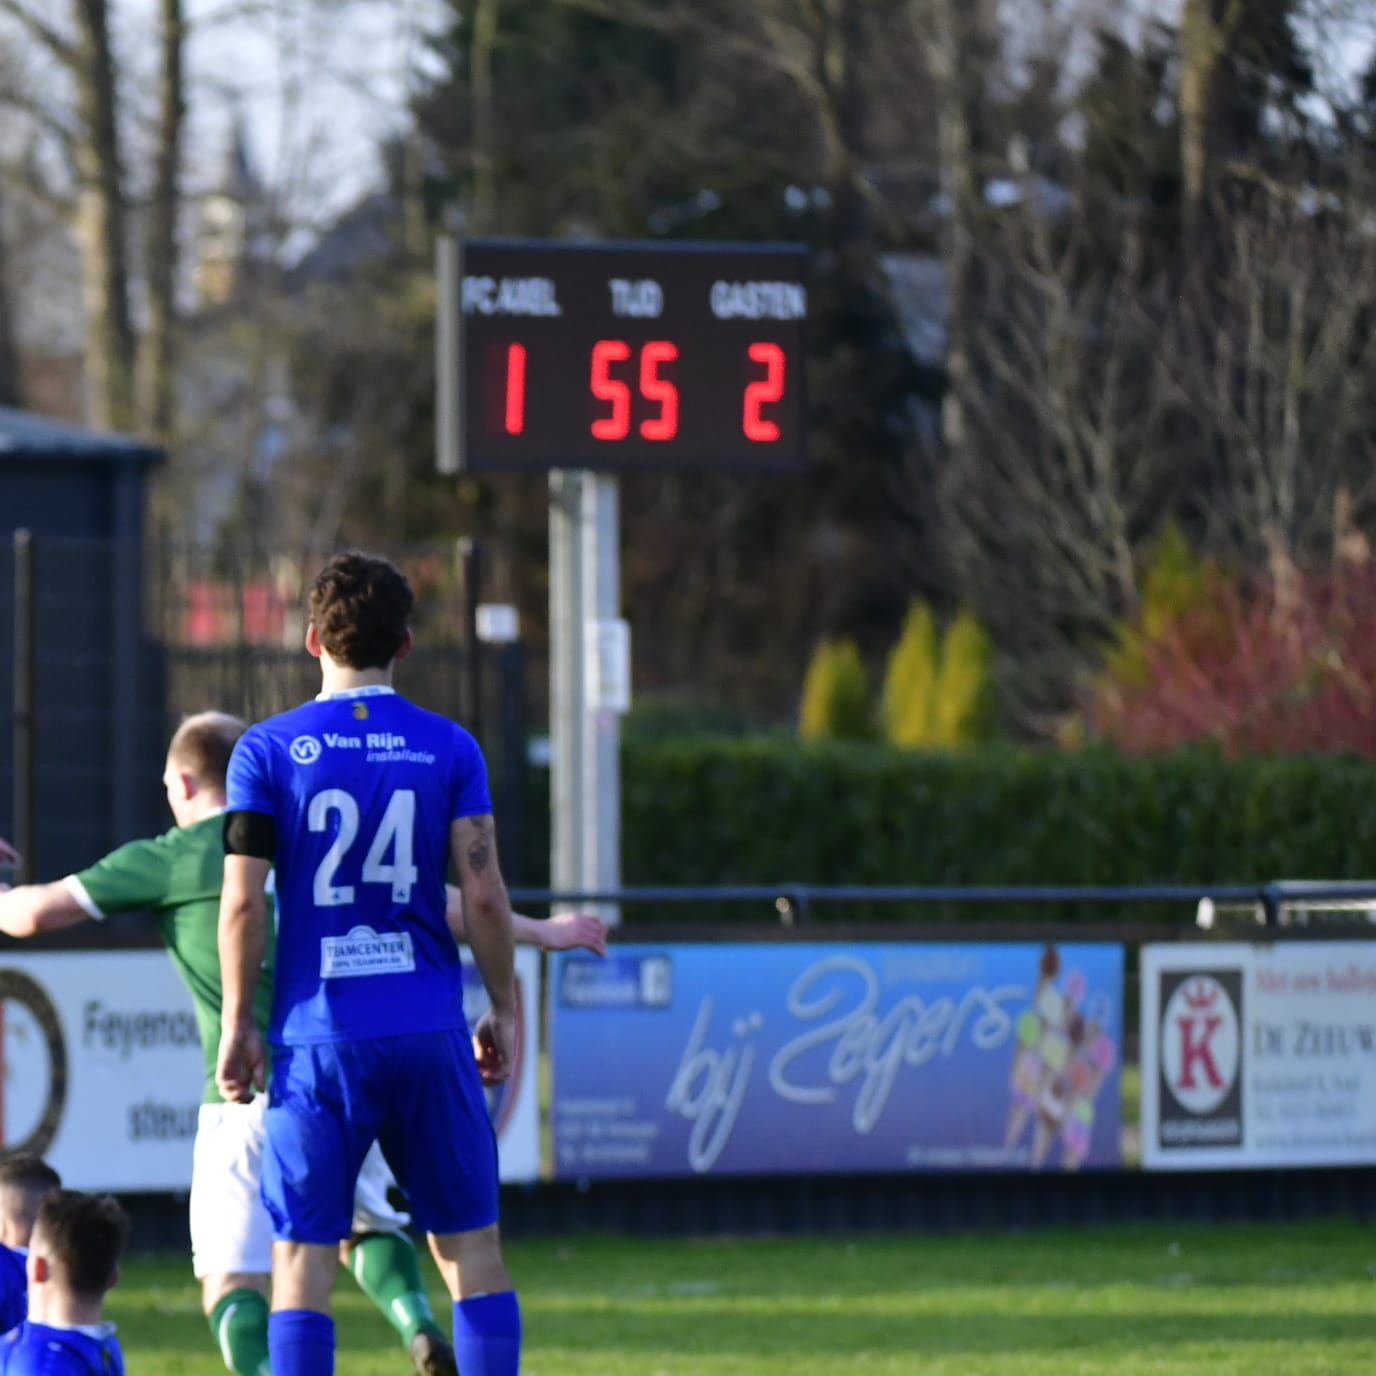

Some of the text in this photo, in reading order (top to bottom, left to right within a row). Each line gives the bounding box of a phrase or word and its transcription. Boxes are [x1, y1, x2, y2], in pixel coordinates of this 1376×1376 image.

[461, 276, 498, 316] FC
[709, 279, 807, 320] GASTEN
[504, 341, 527, 436] 1
[589, 339, 680, 442] 55
[742, 341, 787, 443] 2
[322, 732, 407, 751] Van Rijn
[366, 749, 436, 765] installatie
[307, 787, 418, 907] 24
[1176, 1014, 1224, 1090] K
